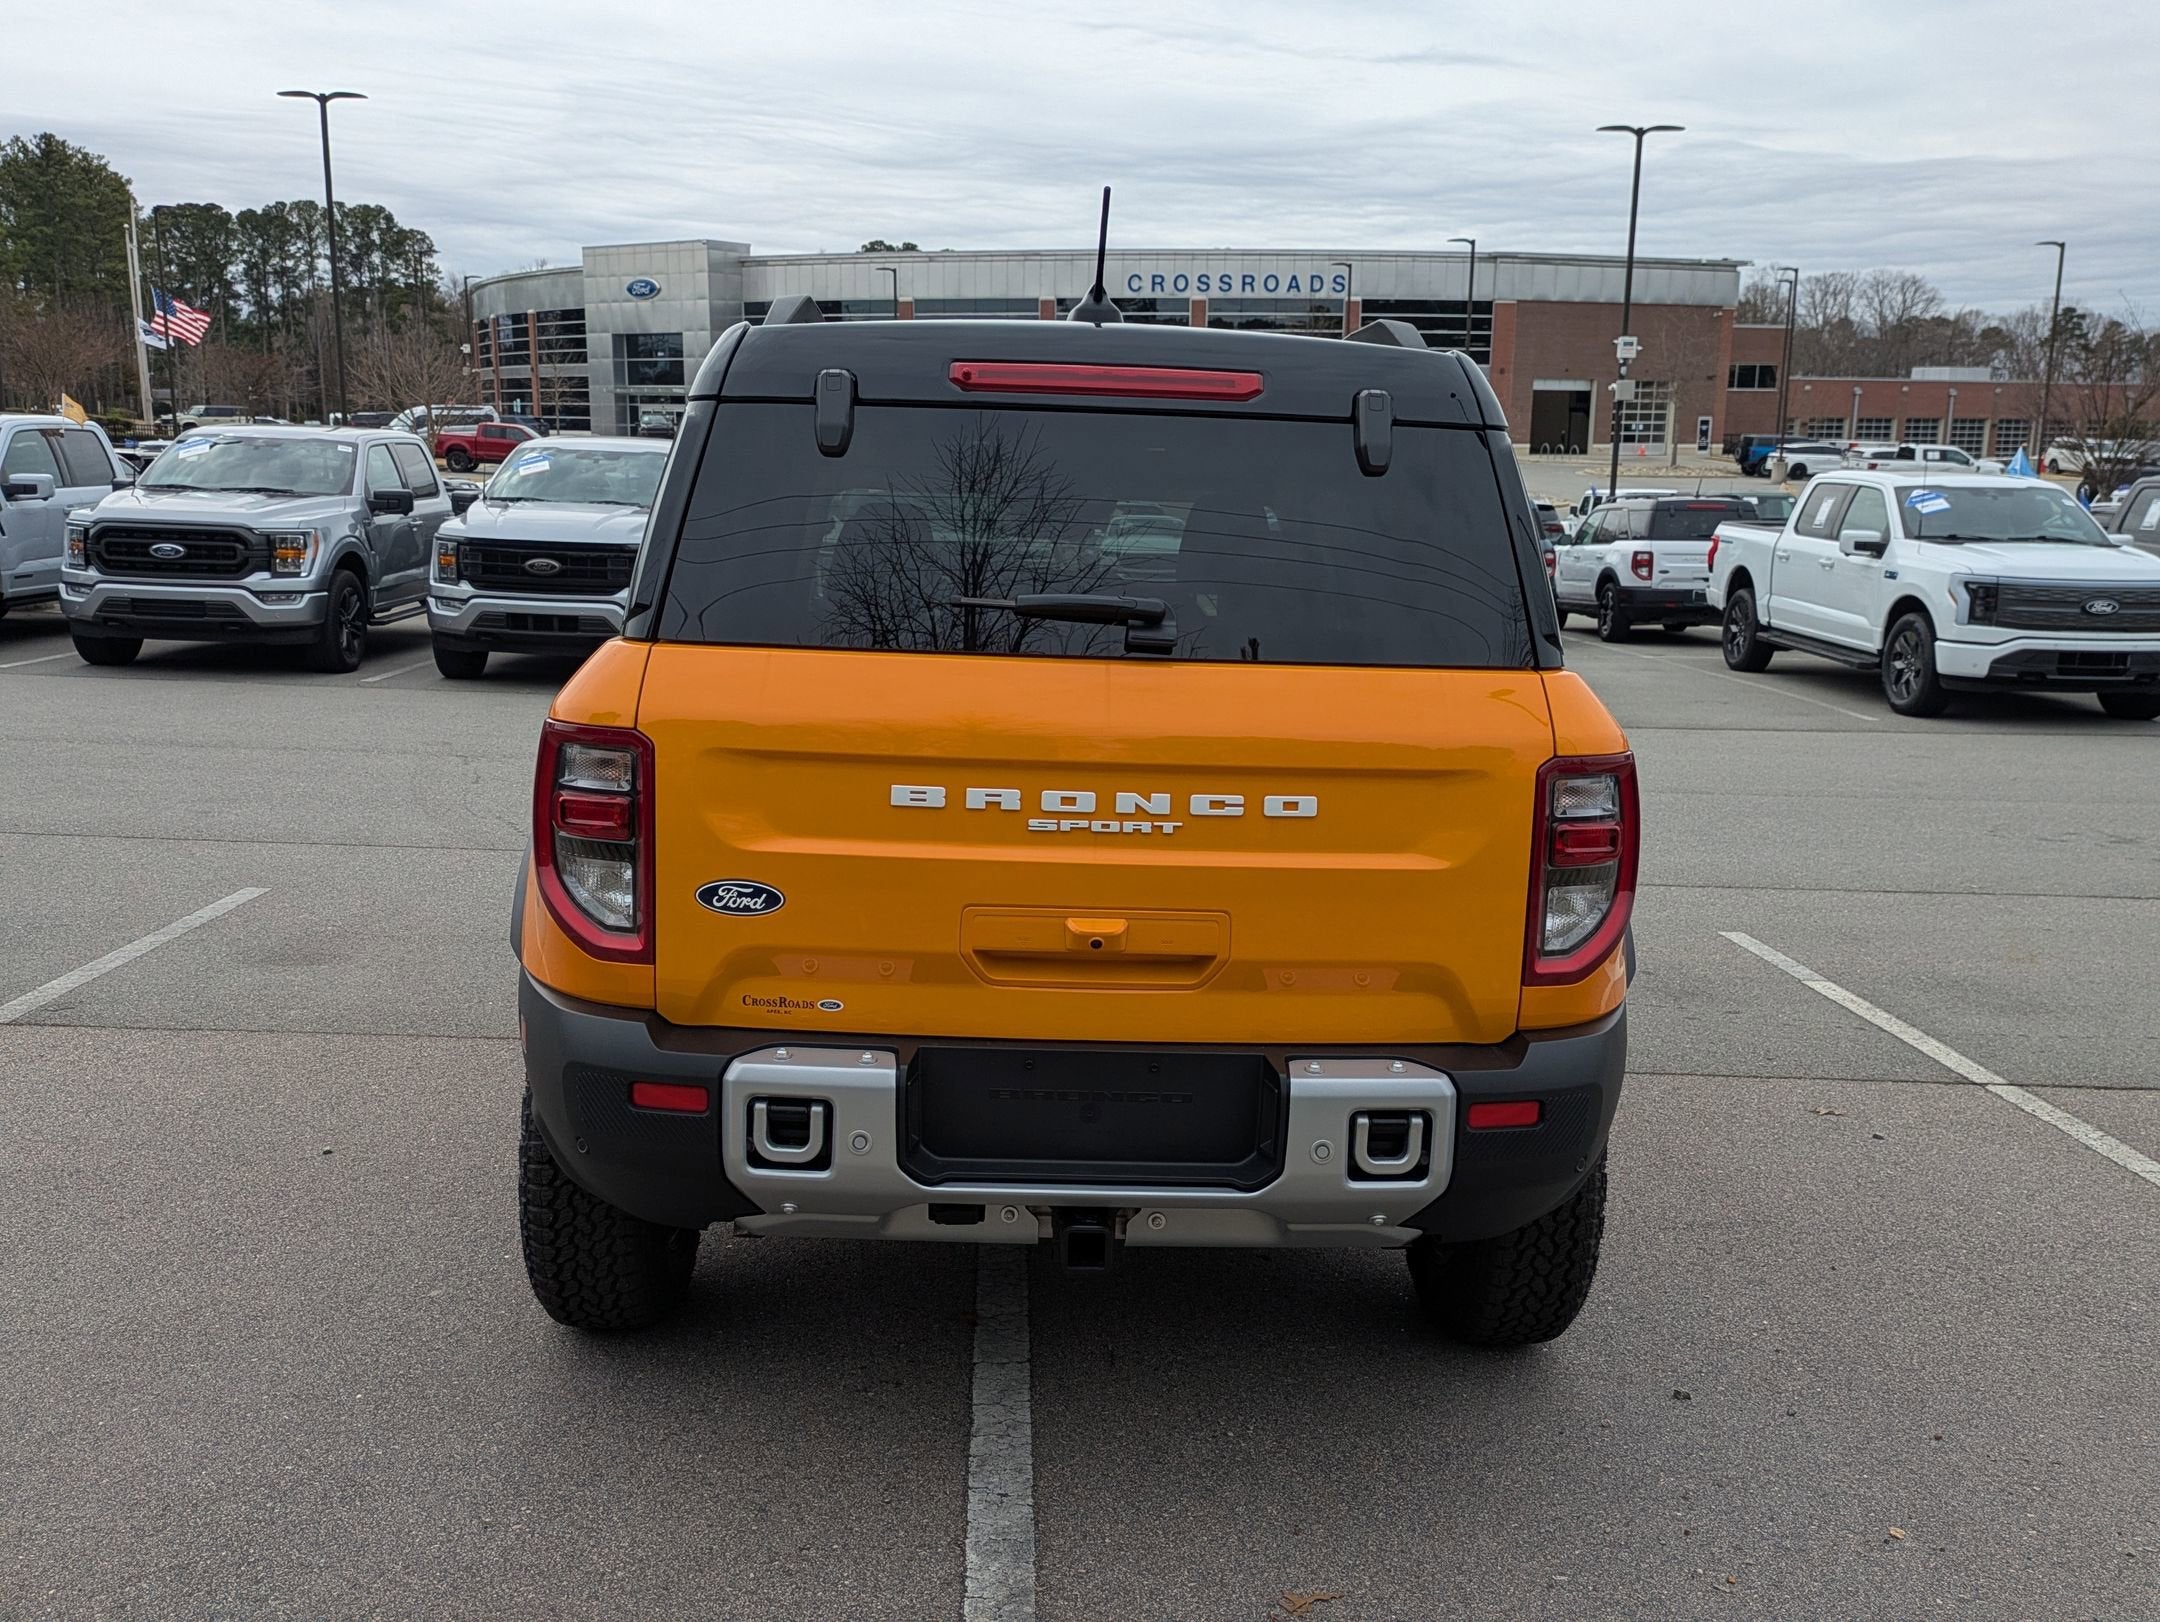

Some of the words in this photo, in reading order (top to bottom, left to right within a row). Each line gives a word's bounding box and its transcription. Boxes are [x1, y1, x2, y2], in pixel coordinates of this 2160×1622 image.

[1127, 273, 1346, 293] CROSSROADS
[890, 784, 1318, 817] BRONCO
[1027, 819, 1184, 834] SPORT
[712, 885, 767, 910] Ford
[988, 1087, 1193, 1104] BRONCO
